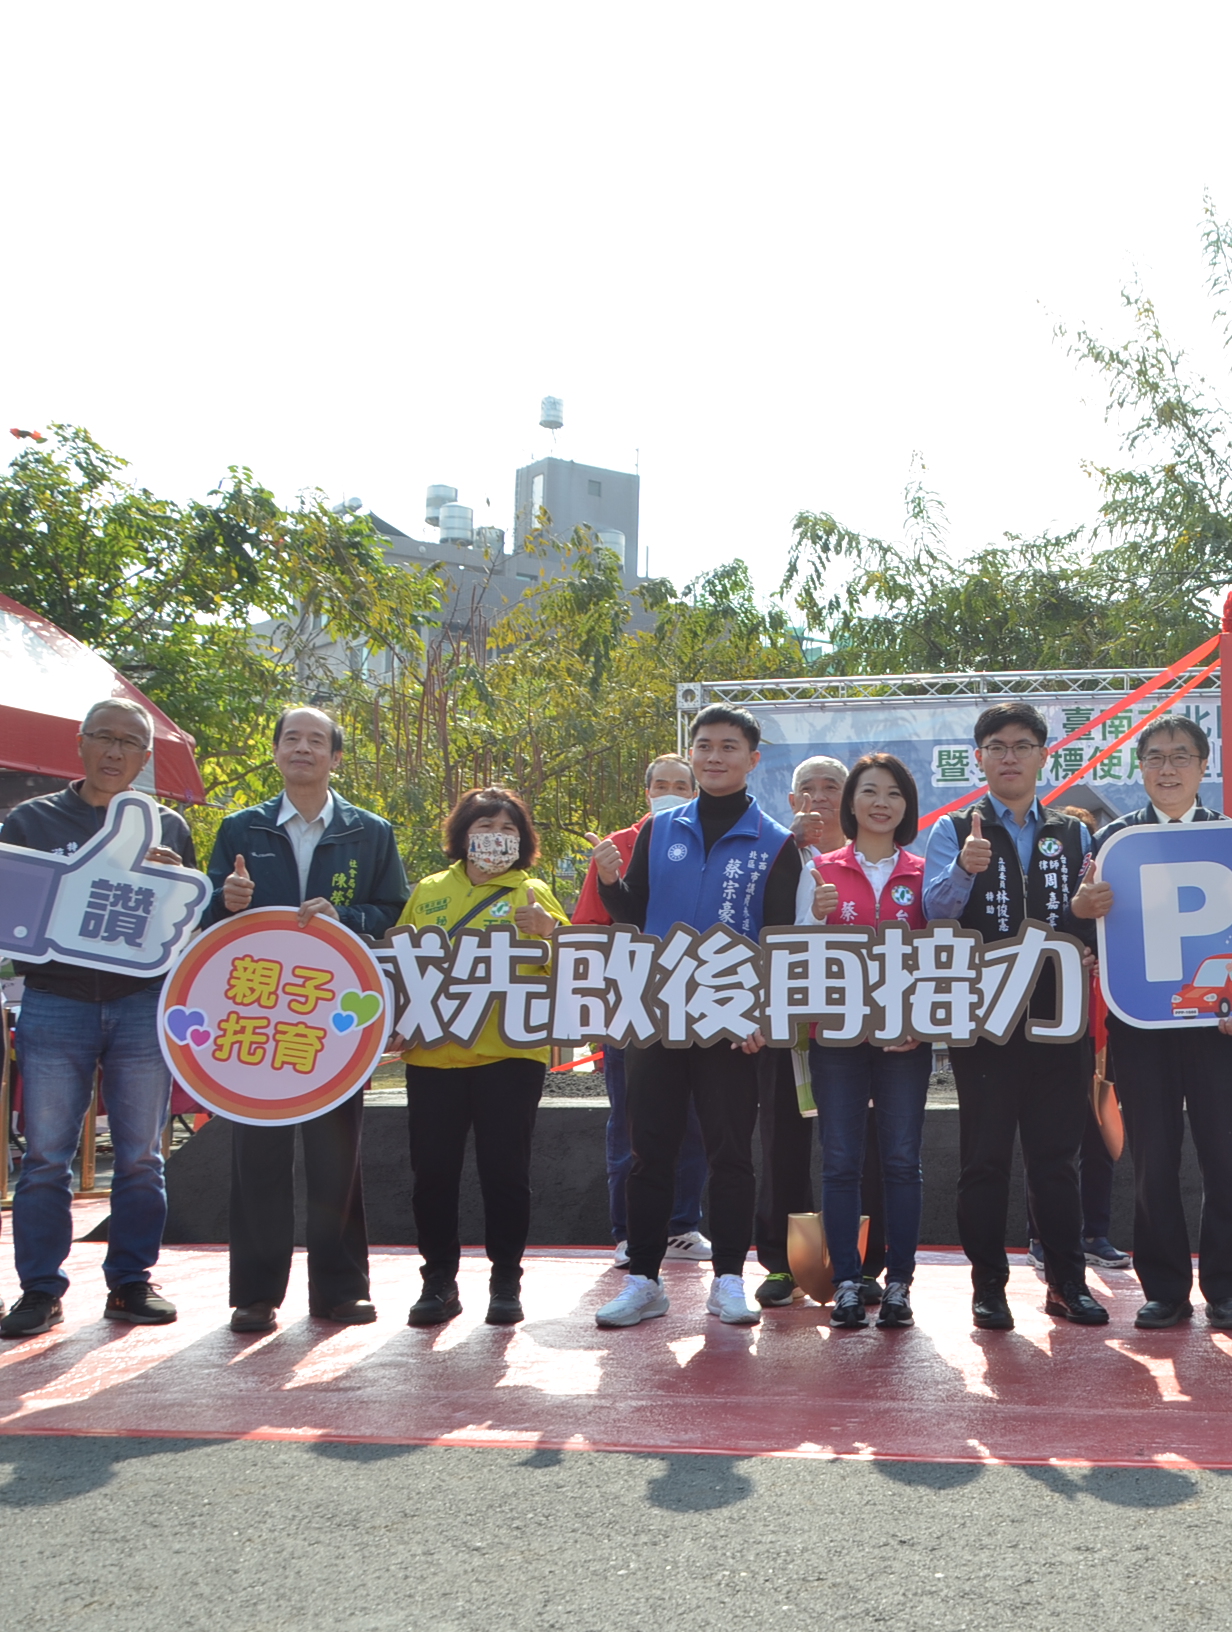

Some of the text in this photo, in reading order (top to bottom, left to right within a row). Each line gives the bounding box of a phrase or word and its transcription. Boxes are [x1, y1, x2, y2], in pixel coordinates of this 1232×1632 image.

[717, 858, 745, 924] 蔡宗豪
[1039, 860, 1060, 871] 律師
[77, 876, 158, 949] 讚
[225, 955, 335, 1015] 親子
[213, 1012, 327, 1073] 托育
